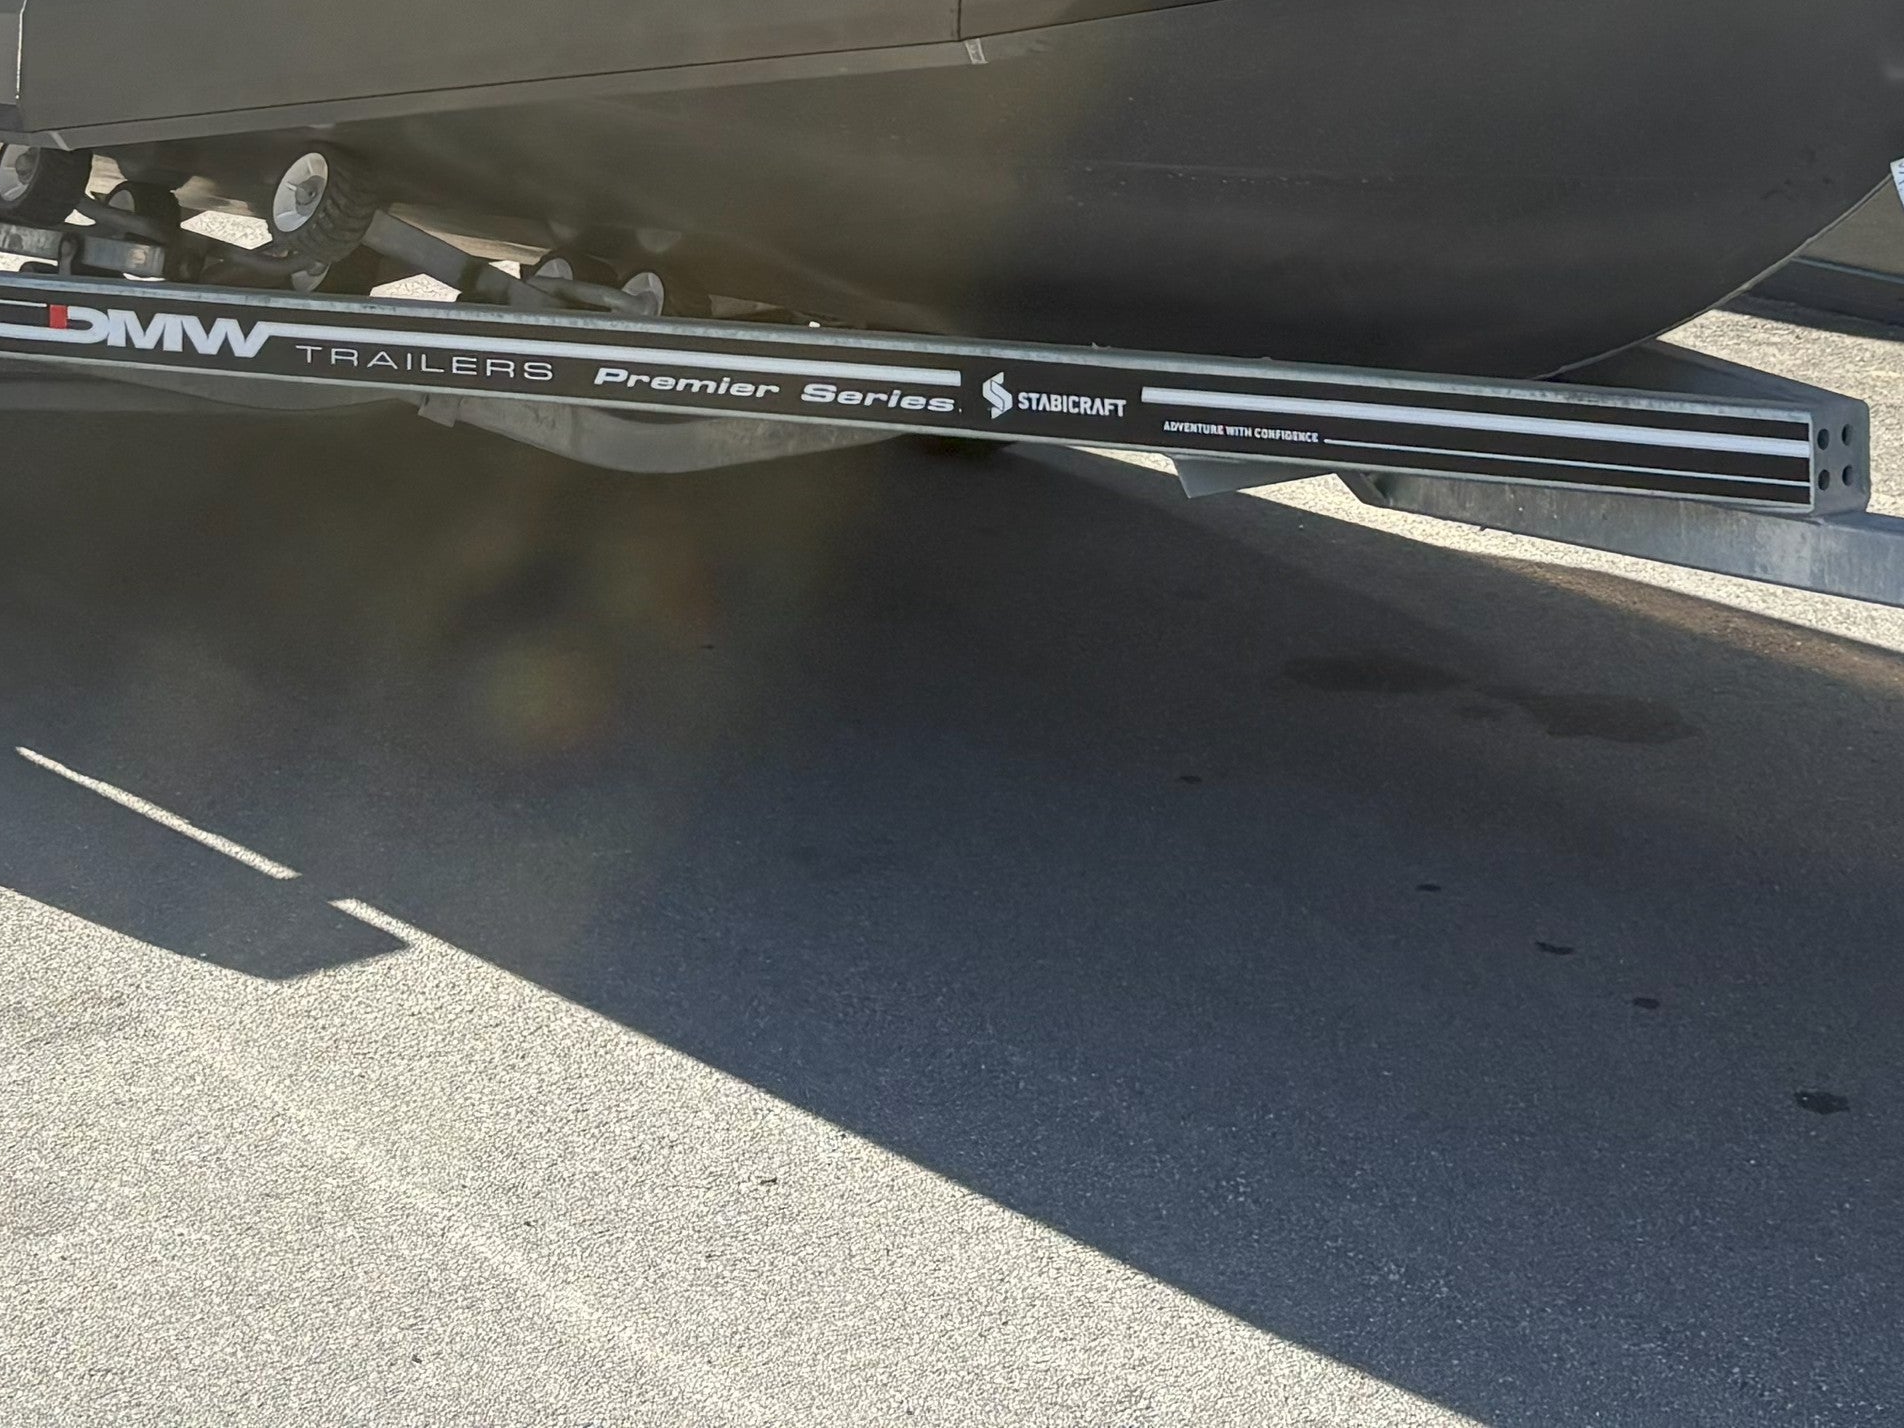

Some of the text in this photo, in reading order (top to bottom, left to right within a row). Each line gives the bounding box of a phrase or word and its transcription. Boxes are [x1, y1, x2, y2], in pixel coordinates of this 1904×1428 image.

[49, 304, 955, 413] DMW TRAILERS Premier Series
[1018, 392, 1127, 418] STABICRAFT
[1163, 420, 1319, 443] ADVENTURE WITH CONFIDENCE
